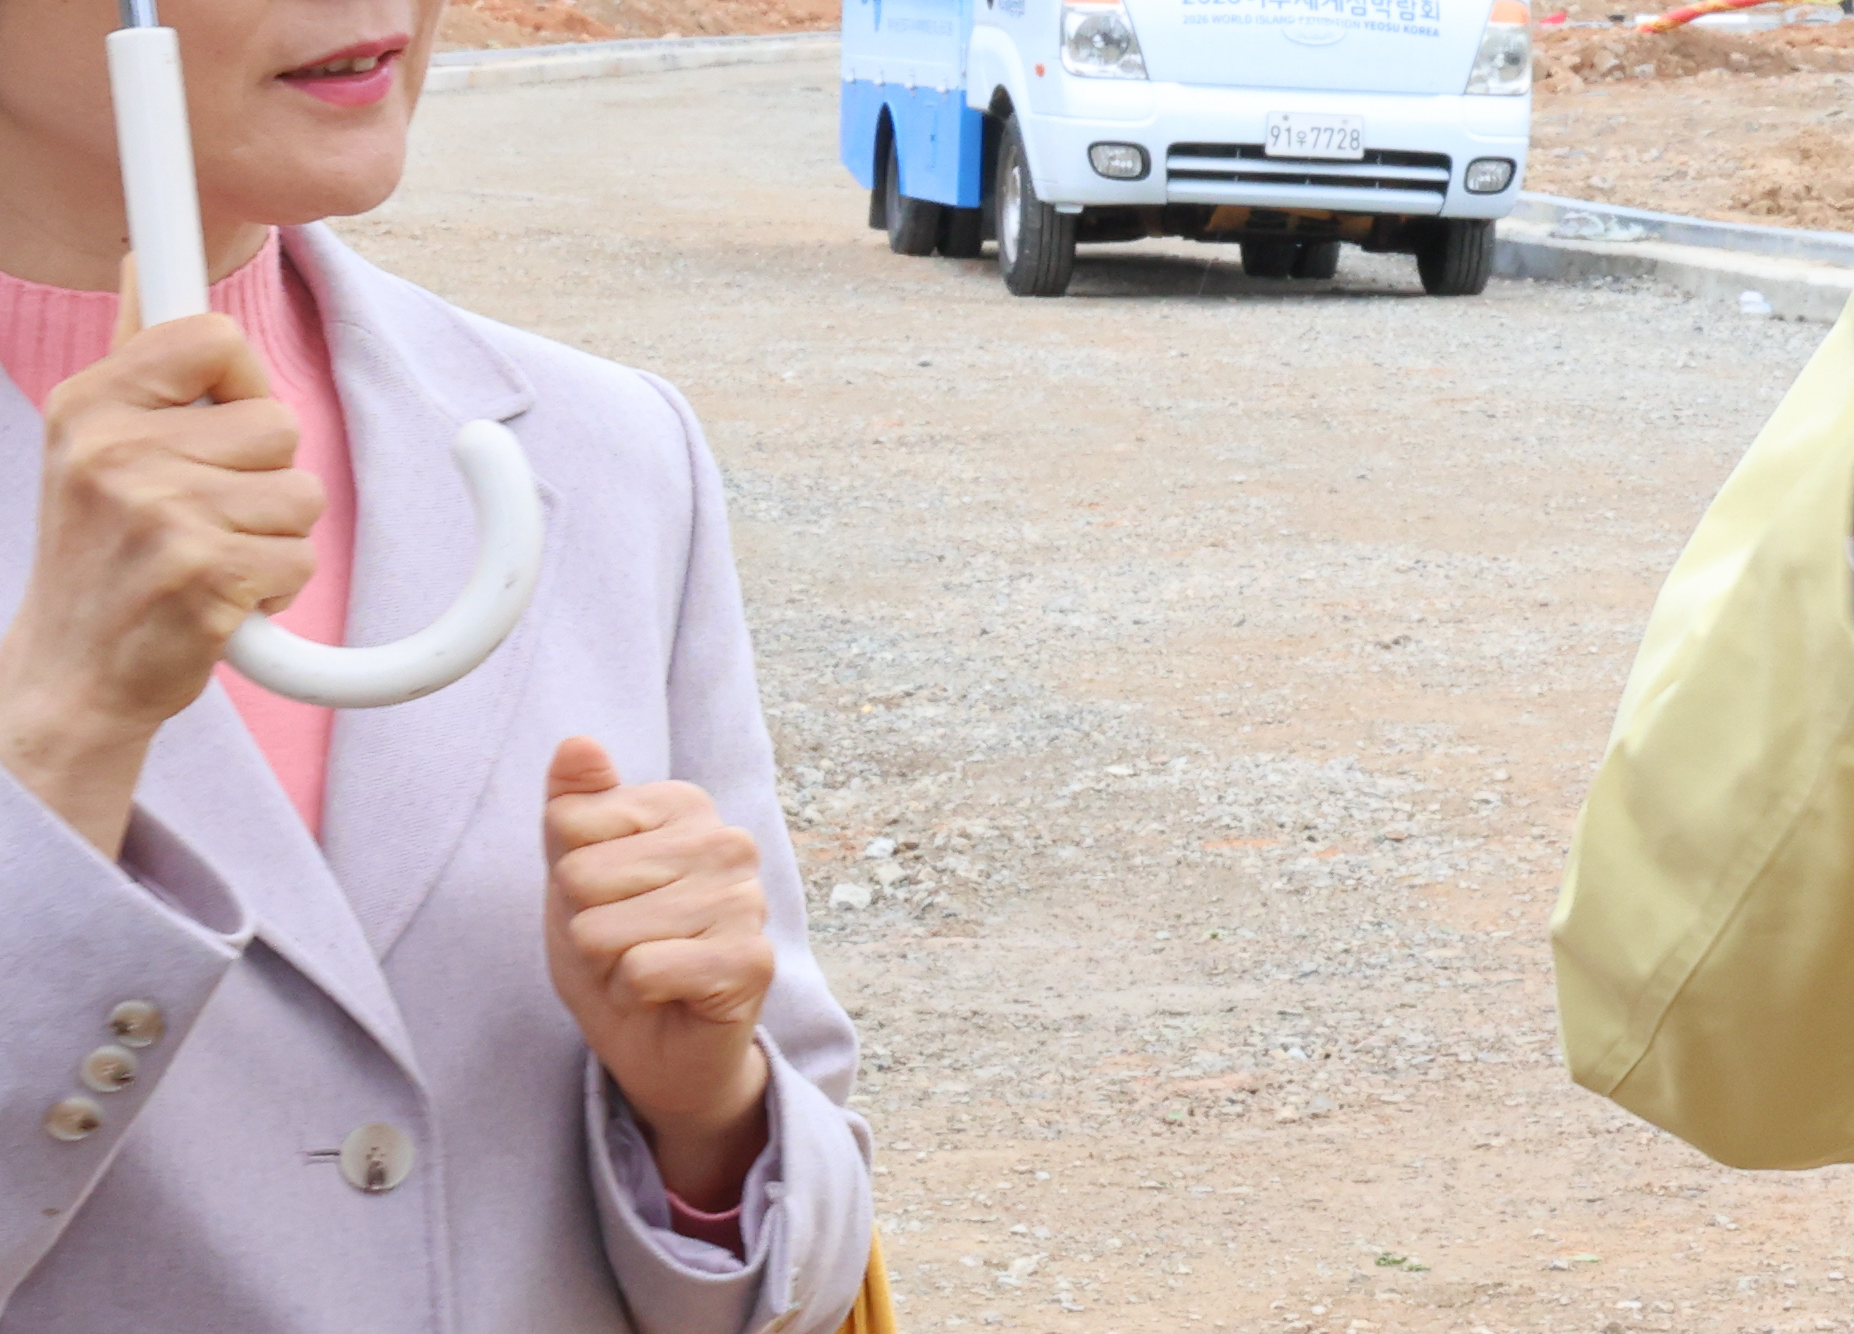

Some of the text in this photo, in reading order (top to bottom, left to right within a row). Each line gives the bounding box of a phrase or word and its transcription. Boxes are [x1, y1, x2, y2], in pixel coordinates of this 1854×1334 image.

[1183, 14, 1209, 25] 2026
[1212, 14, 1252, 26] WORLD
[1363, 20, 1401, 34] YEOSU
[1403, 24, 1440, 38] KOREA
